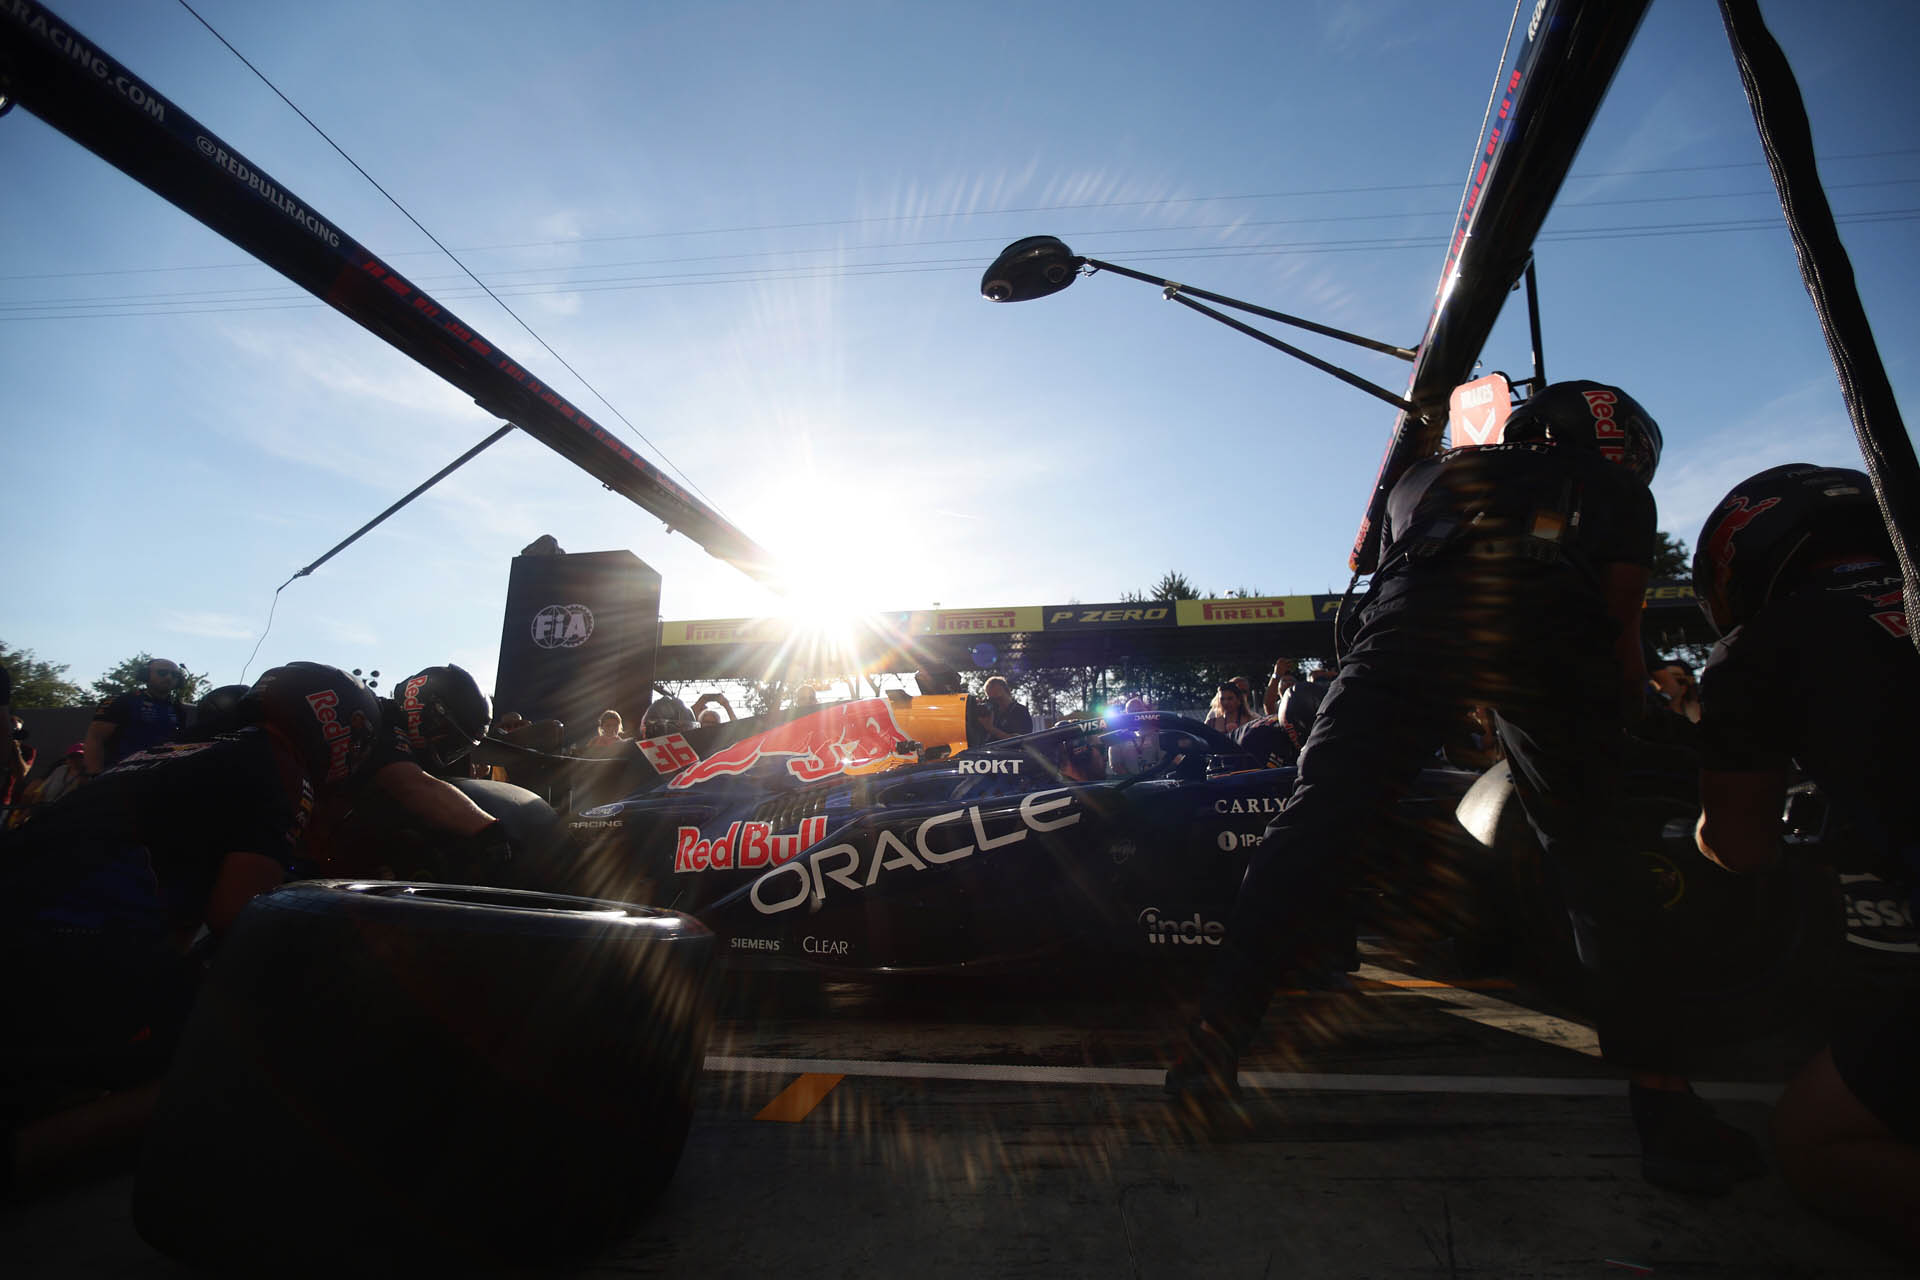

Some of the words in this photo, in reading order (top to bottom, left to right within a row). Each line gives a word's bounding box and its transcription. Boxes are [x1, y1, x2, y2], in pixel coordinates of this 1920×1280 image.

[196, 135, 340, 248] @REDBULLRACING
[1050, 611, 1073, 624] P
[1079, 607, 1169, 622] ZERO
[1202, 601, 1285, 620] PIRELLI
[936, 611, 1016, 631] PIRELLI
[305, 689, 352, 742] Red
[1080, 719, 1107, 732] VISA
[958, 759, 1023, 776] ROKT
[568, 820, 624, 830] RACING
[674, 821, 740, 873] Red
[738, 815, 829, 869] Bull
[749, 786, 1082, 915] ORACLE
[730, 937, 781, 951] SIEMENS
